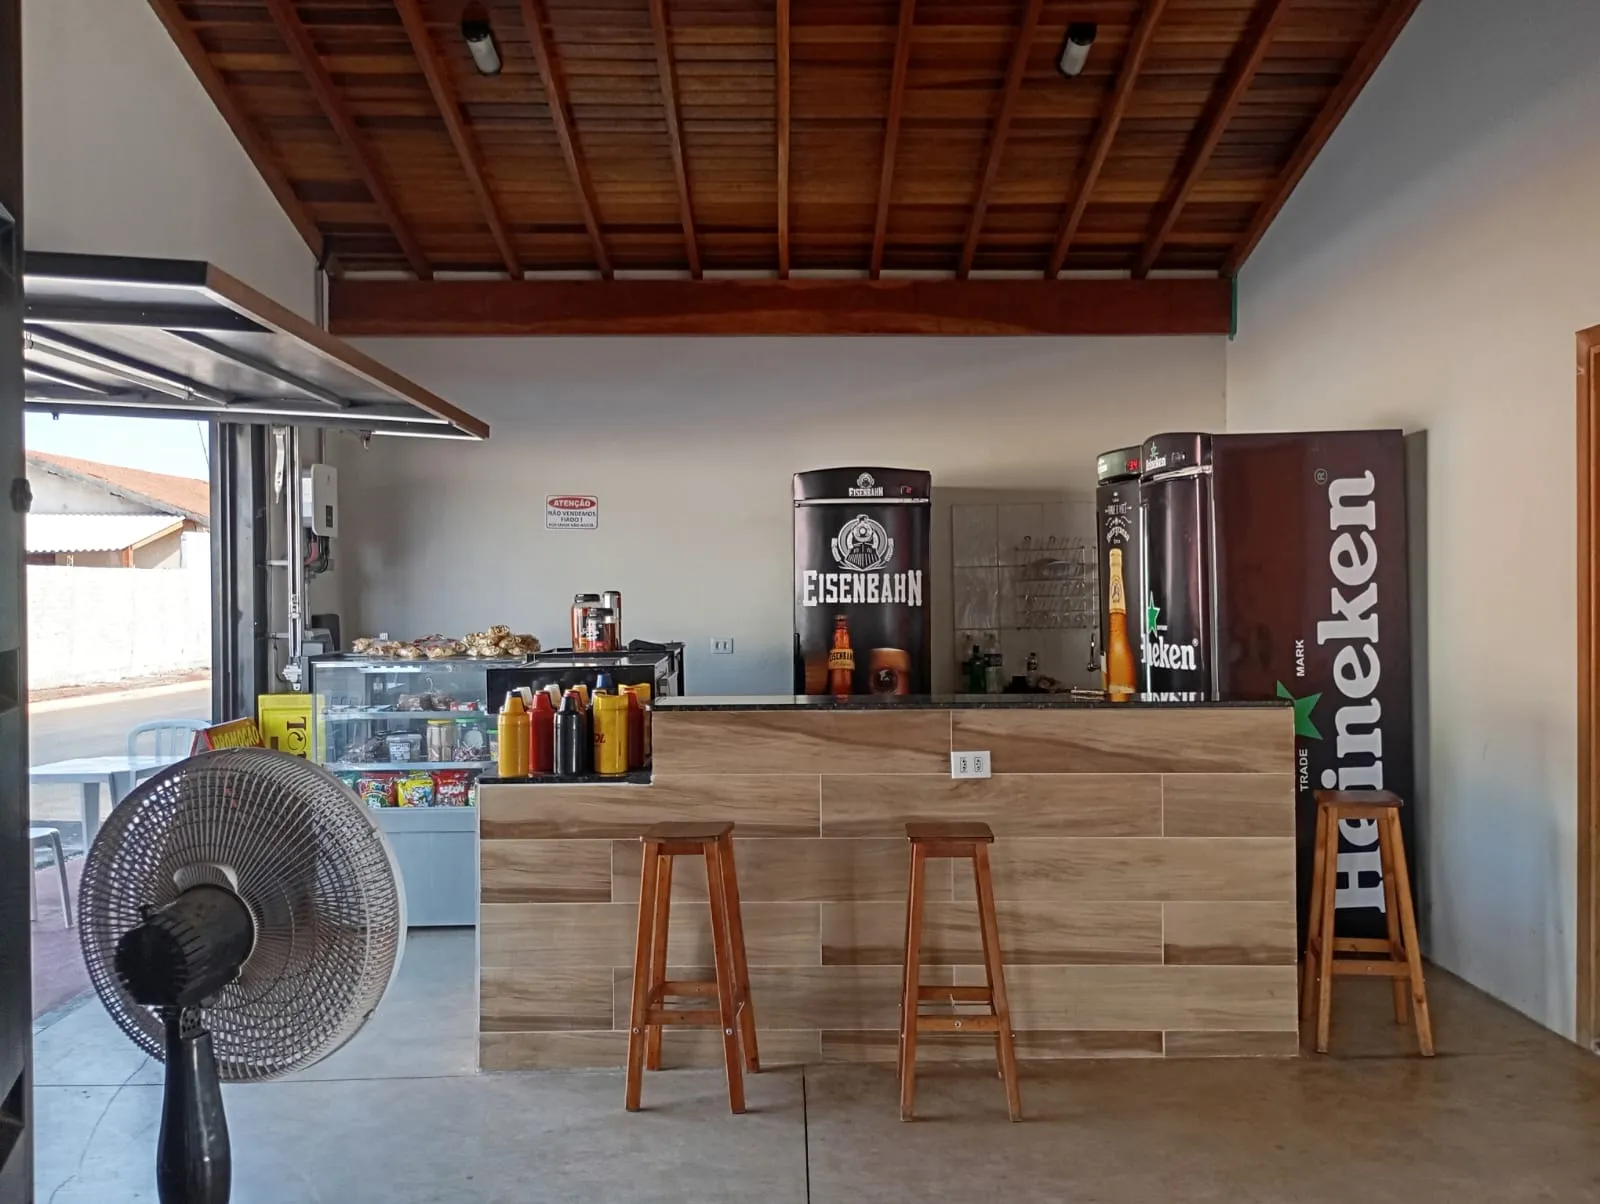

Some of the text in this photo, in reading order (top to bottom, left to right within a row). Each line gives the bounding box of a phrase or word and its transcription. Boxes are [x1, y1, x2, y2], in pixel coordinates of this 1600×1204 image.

[553, 499, 591, 508] ATENÇÃO
[849, 487, 883, 497] EISENBAHN
[803, 570, 922, 606] EISENBAHN
[1295, 639, 1308, 792] TRADE MARK
